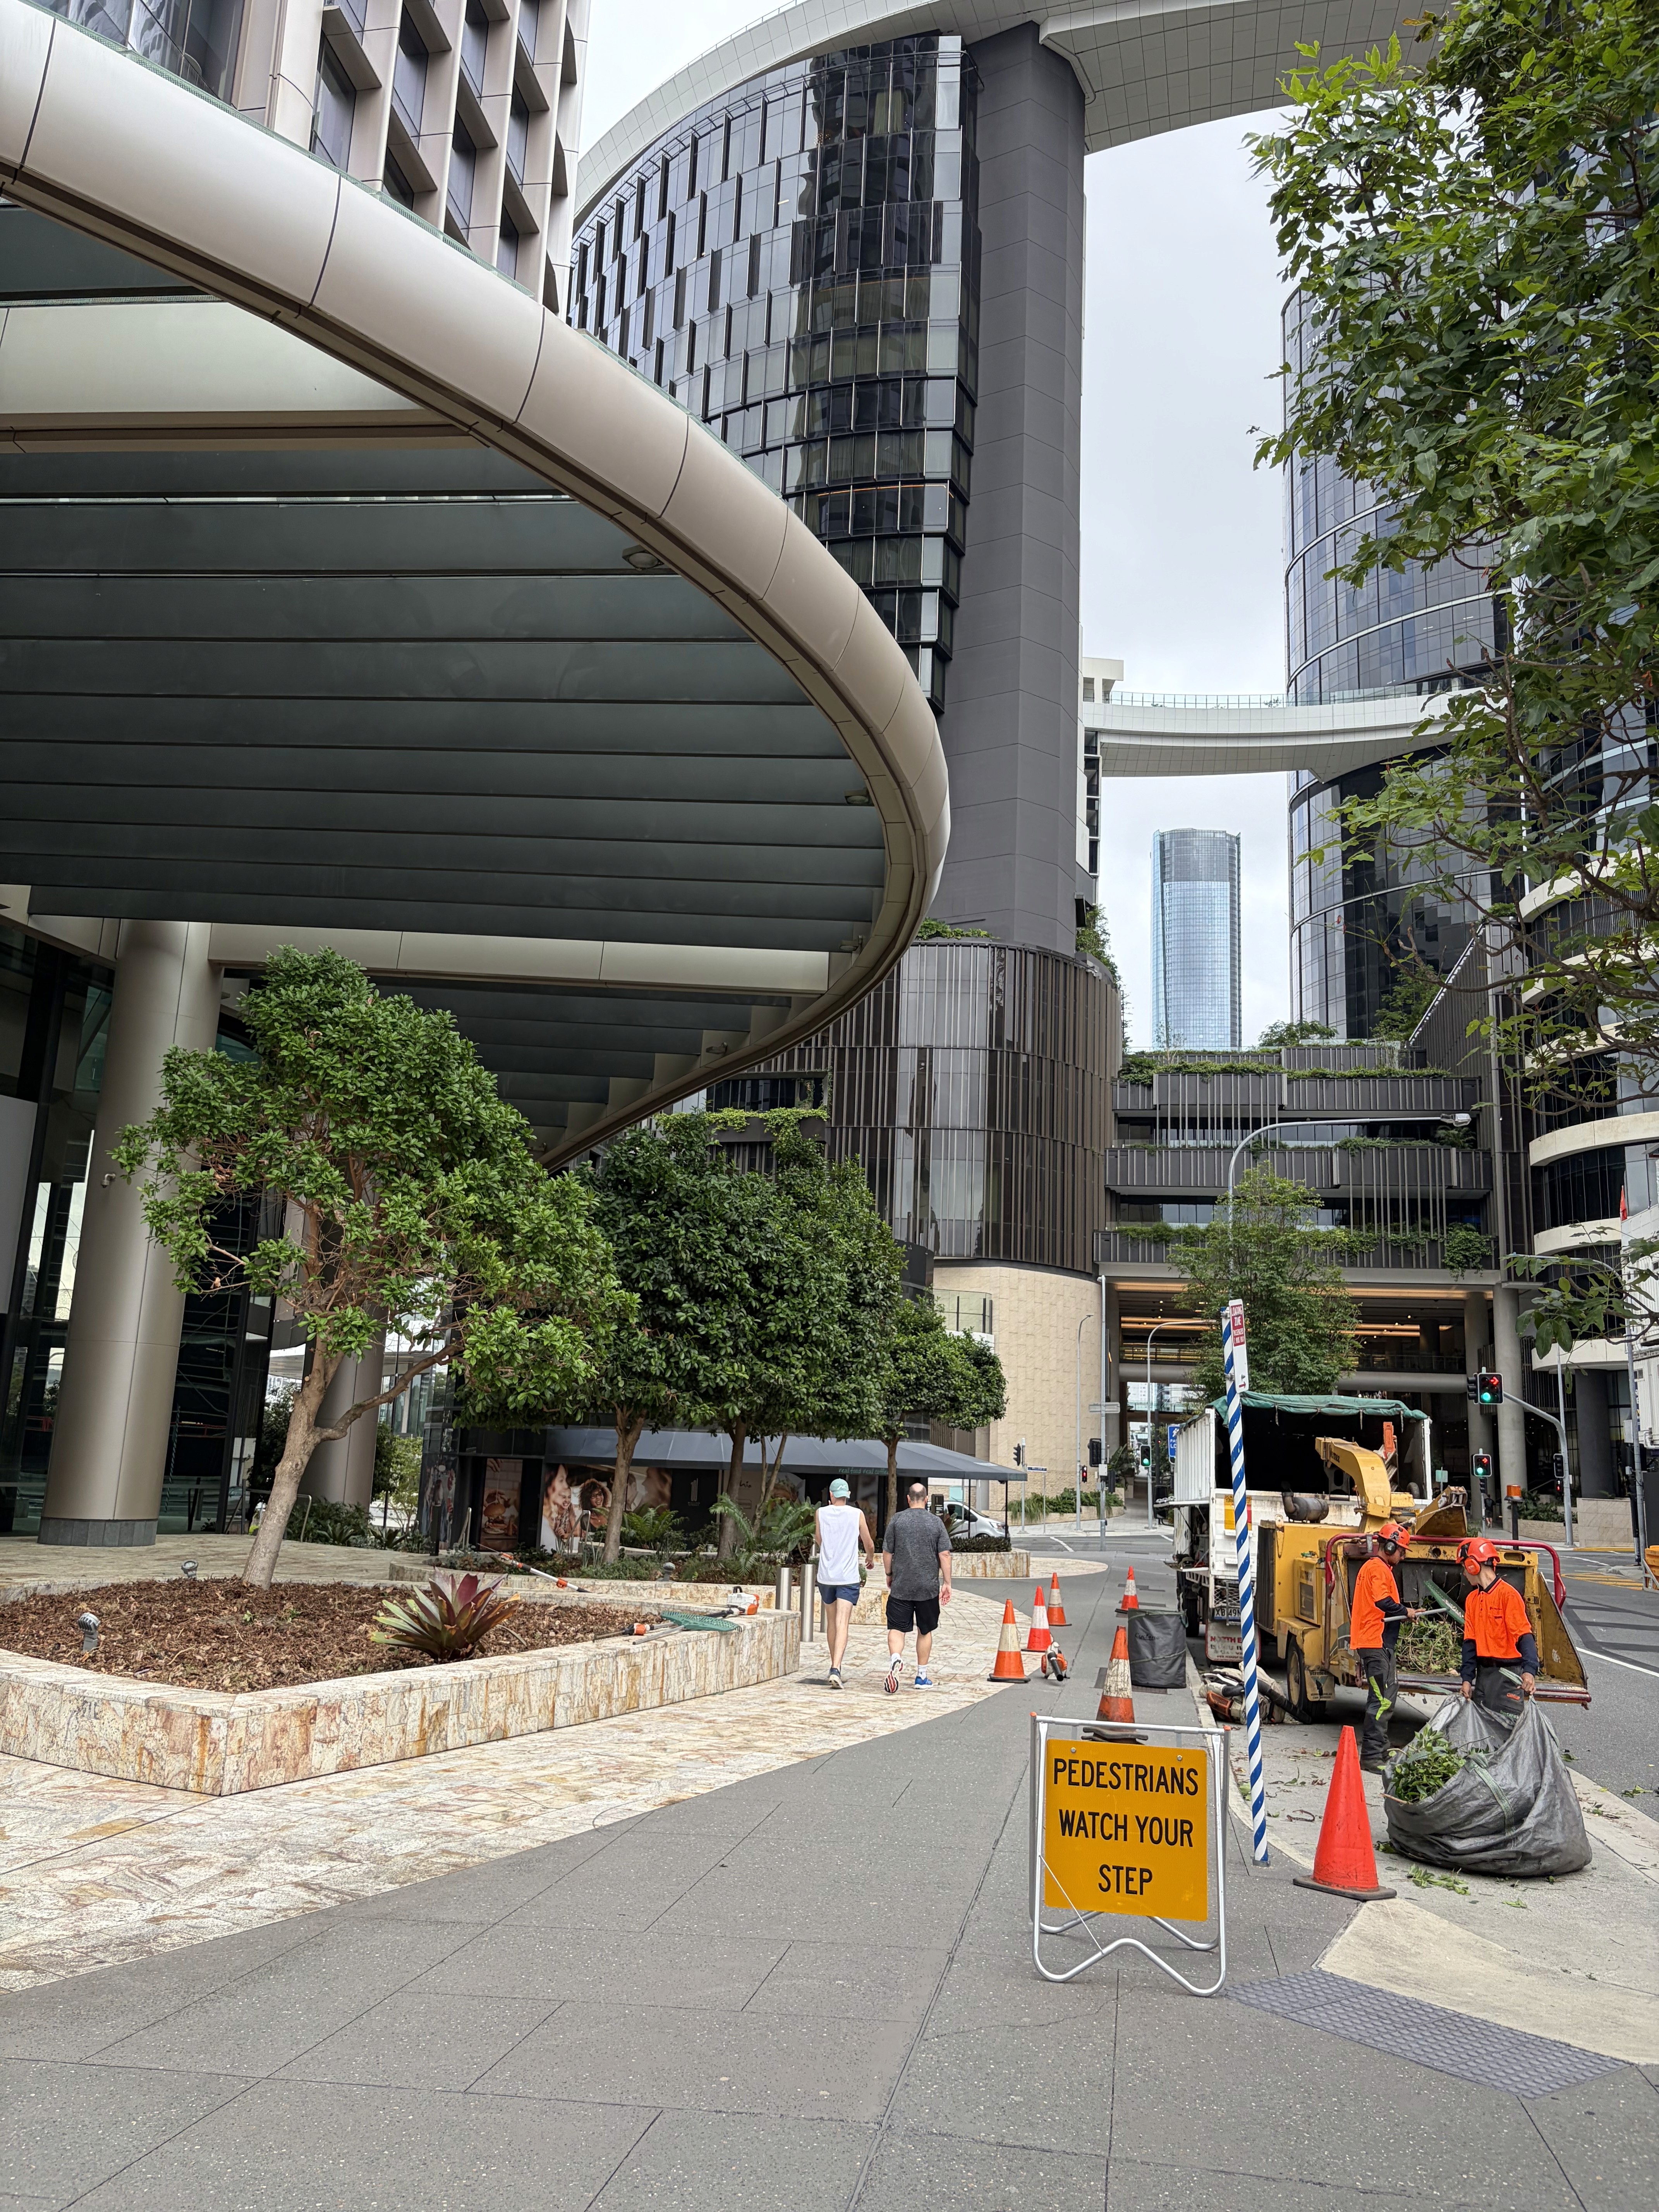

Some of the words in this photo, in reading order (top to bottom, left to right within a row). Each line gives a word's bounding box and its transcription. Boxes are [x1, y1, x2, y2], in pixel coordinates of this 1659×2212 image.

[1054, 1758, 1199, 1796] PEDESTRIANS
[1059, 1809, 1128, 1841] WATCH
[1135, 1815, 1194, 1847] YOUR
[1098, 1864, 1153, 1896] STEP
